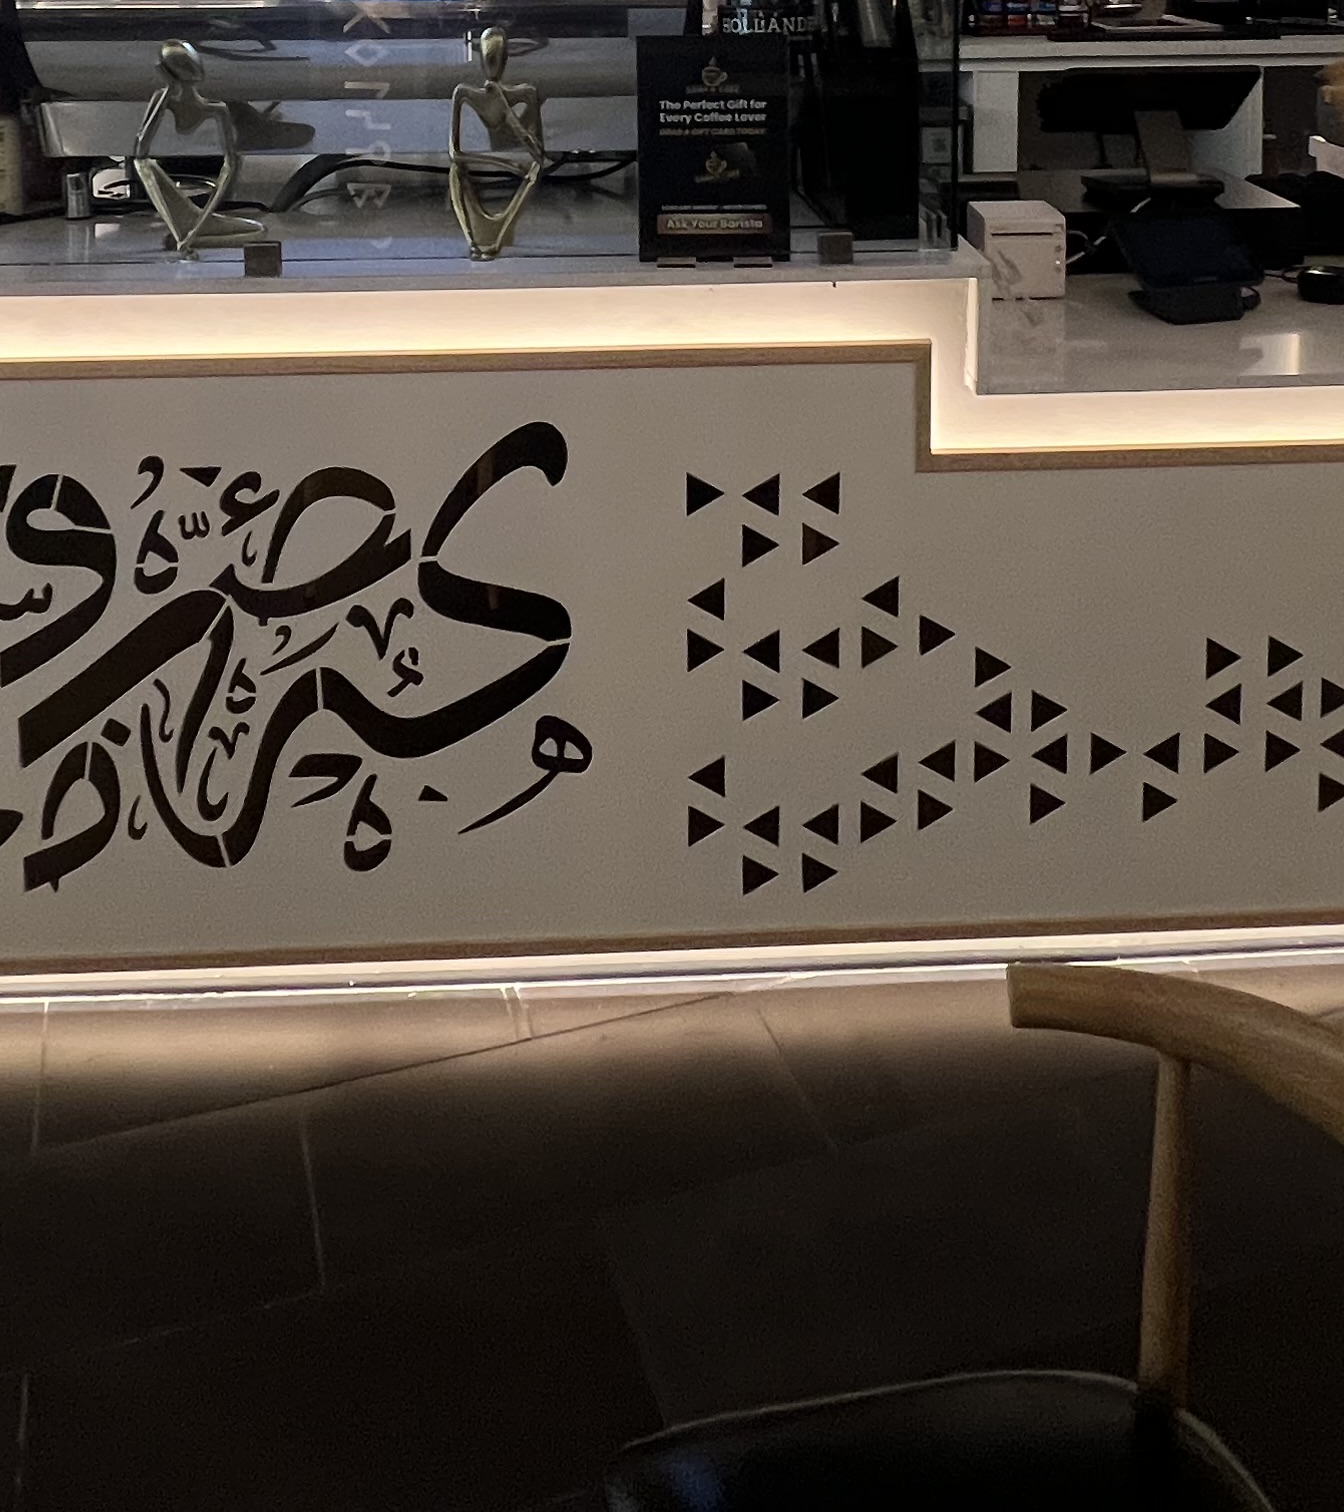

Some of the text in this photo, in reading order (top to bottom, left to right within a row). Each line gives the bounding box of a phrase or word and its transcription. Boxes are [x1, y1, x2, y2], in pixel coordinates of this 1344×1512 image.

[659, 99, 767, 110] The Perfect Gift for
[659, 112, 767, 124] Every Coffee Lover
[667, 219, 763, 229] Ask Your Barista
